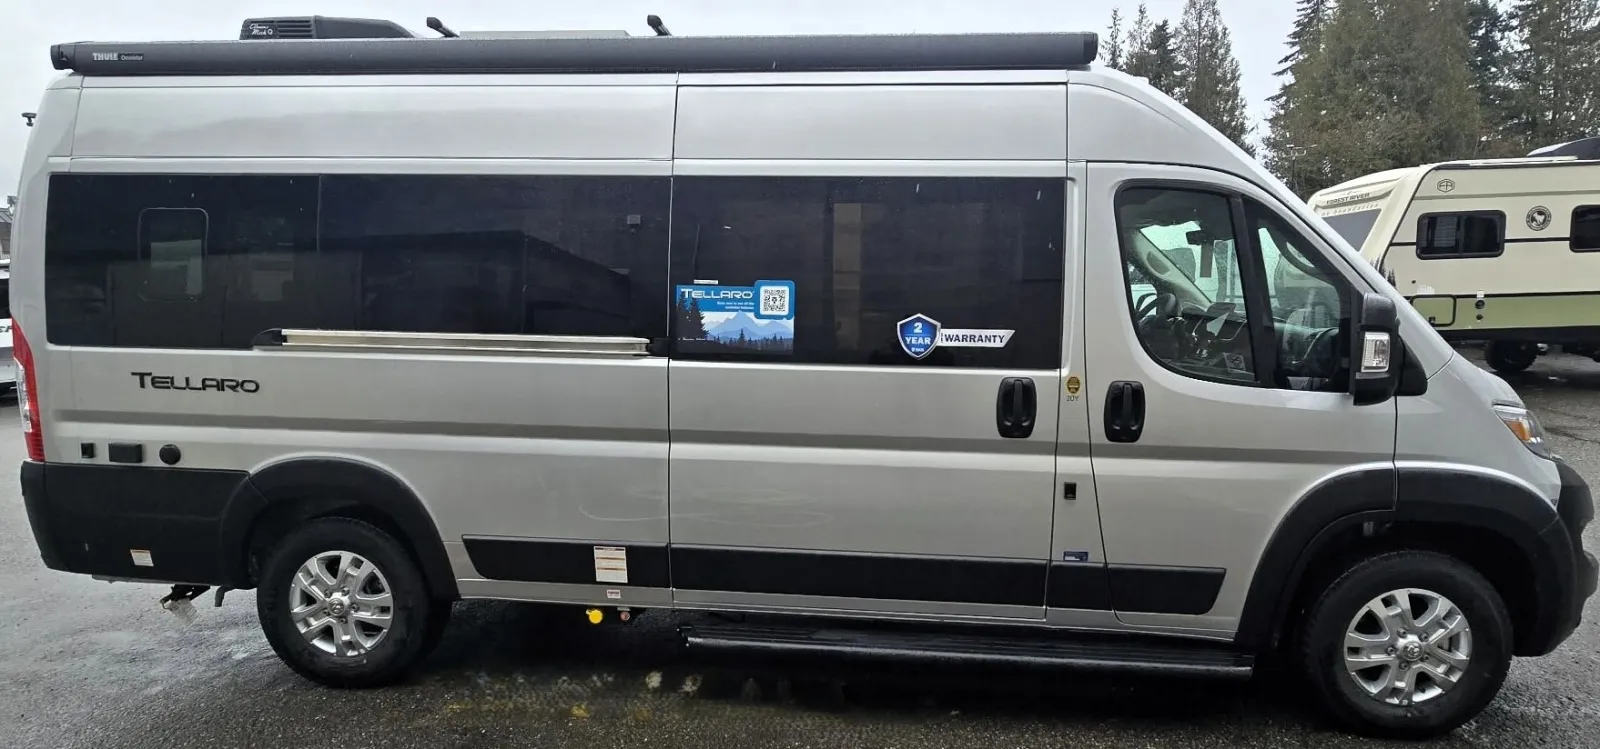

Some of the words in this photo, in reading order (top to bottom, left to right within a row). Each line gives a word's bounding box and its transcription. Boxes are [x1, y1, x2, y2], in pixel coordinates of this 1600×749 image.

[92, 52, 118, 61] THULE
[1326, 196, 1348, 204] FOREST
[681, 288, 753, 299] TELLARO
[913, 322, 923, 333] 2
[905, 337, 931, 345] YEAR
[944, 334, 1006, 343] WARRANTY
[131, 372, 260, 393] TELLARO
